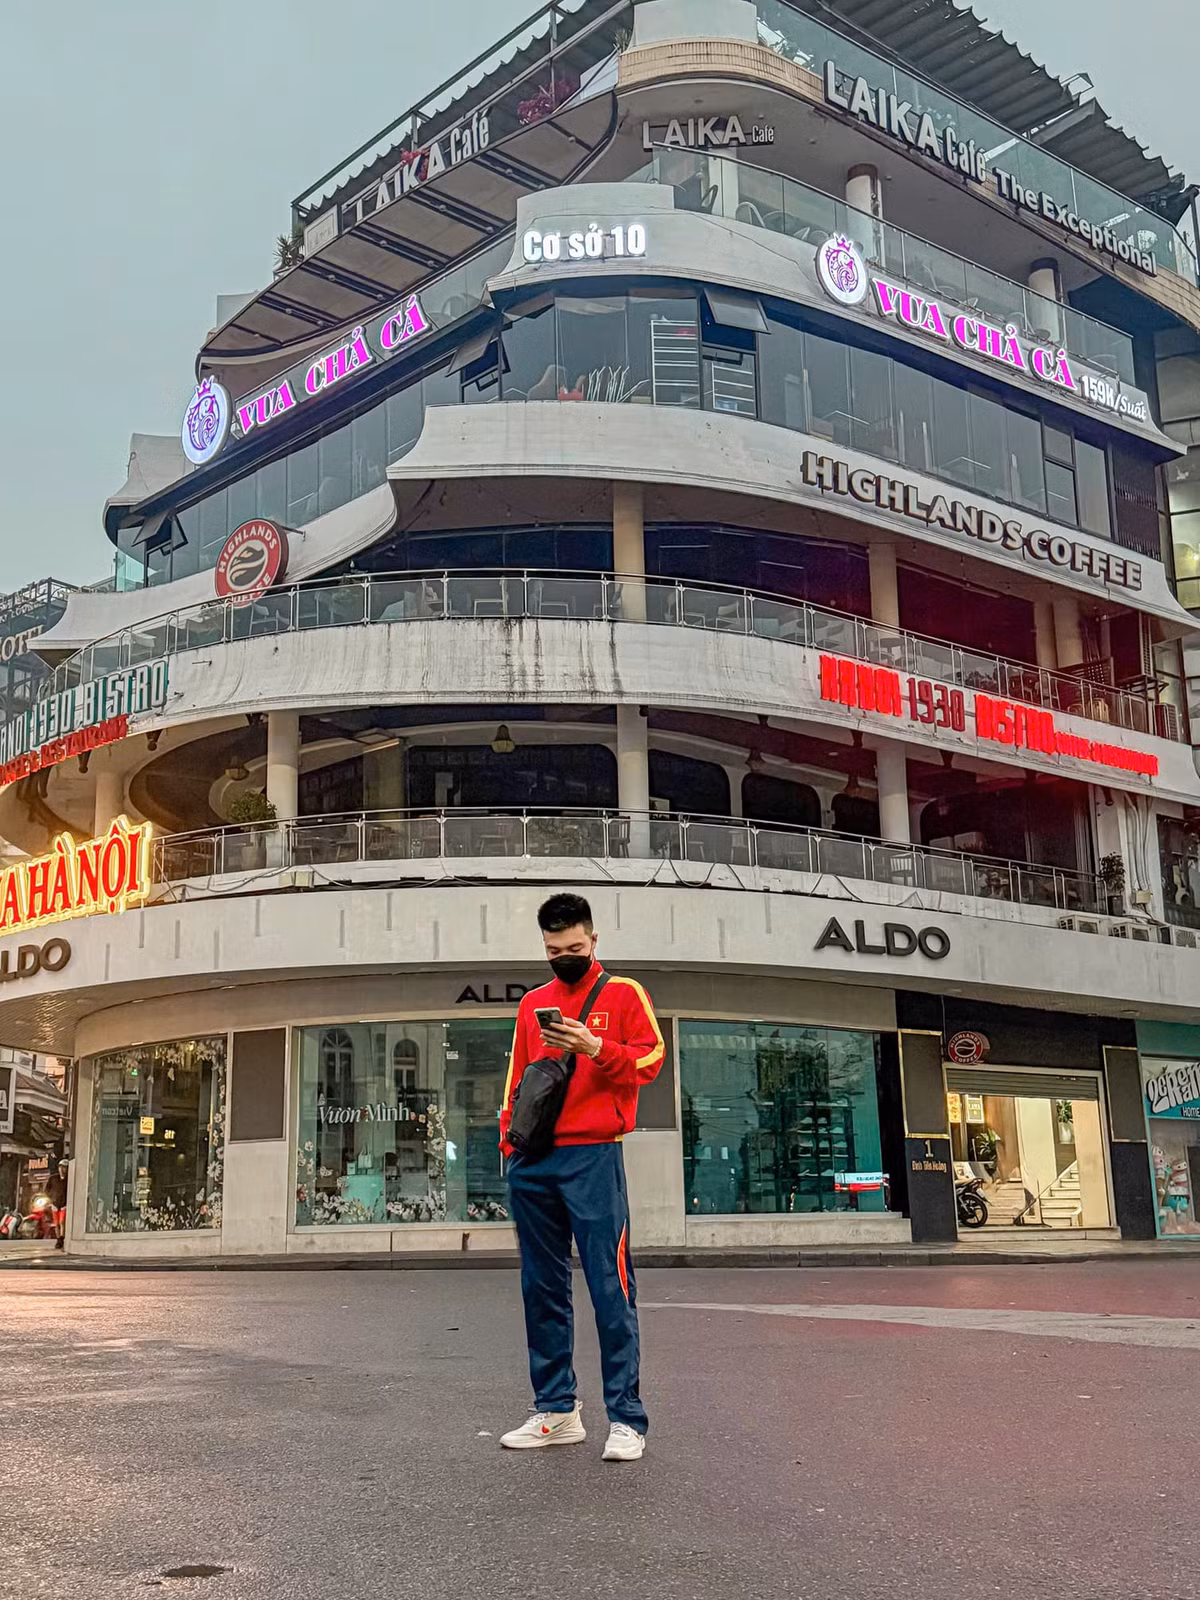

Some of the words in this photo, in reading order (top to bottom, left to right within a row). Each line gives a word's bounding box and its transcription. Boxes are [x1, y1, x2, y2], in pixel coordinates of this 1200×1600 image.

[450, 108, 490, 166] Café
[642, 115, 747, 151] LAIKA
[752, 124, 775, 143] Café
[824, 59, 942, 161] LAIKA
[943, 126, 987, 184] Café
[993, 167, 1041, 212] The
[1040, 192, 1158, 278] Exceptional
[523, 230, 560, 261] Cơ
[568, 223, 603, 259] sở
[611, 224, 646, 256] 10
[872, 278, 950, 339] VUA
[952, 323, 1028, 371] CHẢ
[1030, 348, 1078, 390] CÁ
[236, 379, 297, 434] VUA
[304, 325, 372, 395] CHẢ
[379, 293, 428, 350] CÁ
[802, 450, 1024, 550] HIGHLANDS
[1024, 529, 1143, 591] COFFEE
[218, 525, 278, 574] HIGHLANDS
[31, 688, 76, 750] 1930
[83, 660, 169, 727] BISTRO
[906, 676, 966, 732] 1930
[813, 916, 951, 960] ALDO
[455, 983, 545, 1004] ALD
[365, 1101, 410, 1122] Mình
[925, 1140, 934, 1158] 1
